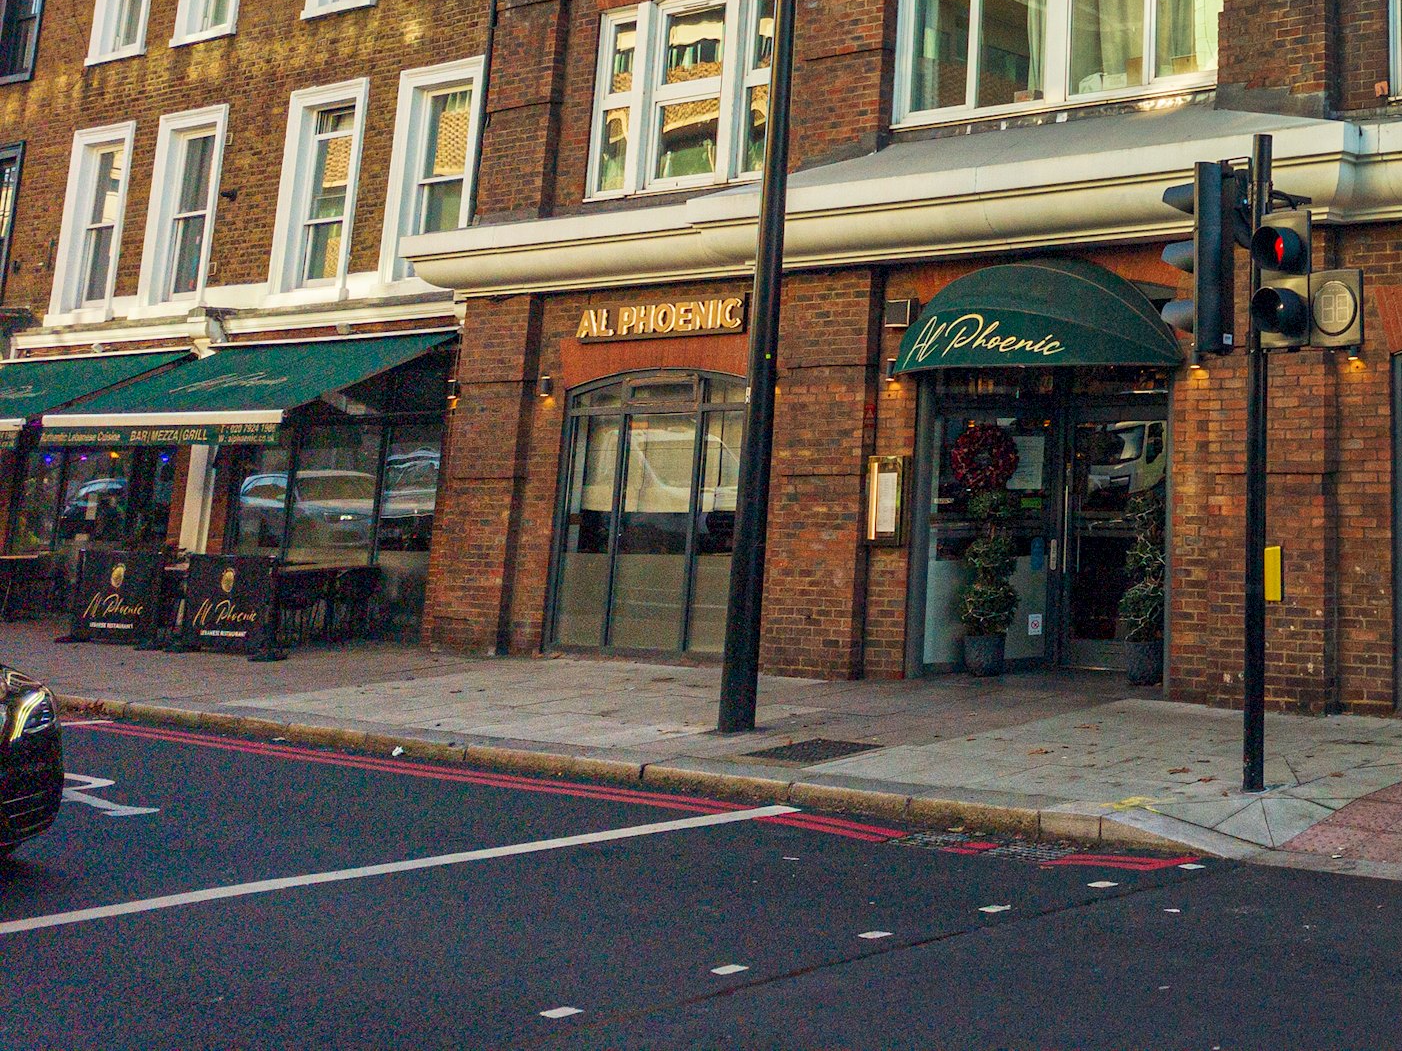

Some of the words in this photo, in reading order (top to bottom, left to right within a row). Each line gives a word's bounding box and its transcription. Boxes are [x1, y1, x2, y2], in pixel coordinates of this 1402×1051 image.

[575, 308, 614, 338] AL
[617, 297, 743, 336] PHOENIC
[902, 315, 947, 370] Al
[941, 313, 1066, 358] Phoenic
[102, 593, 143, 617] Phoenic
[215, 600, 256, 625] Phoenic
